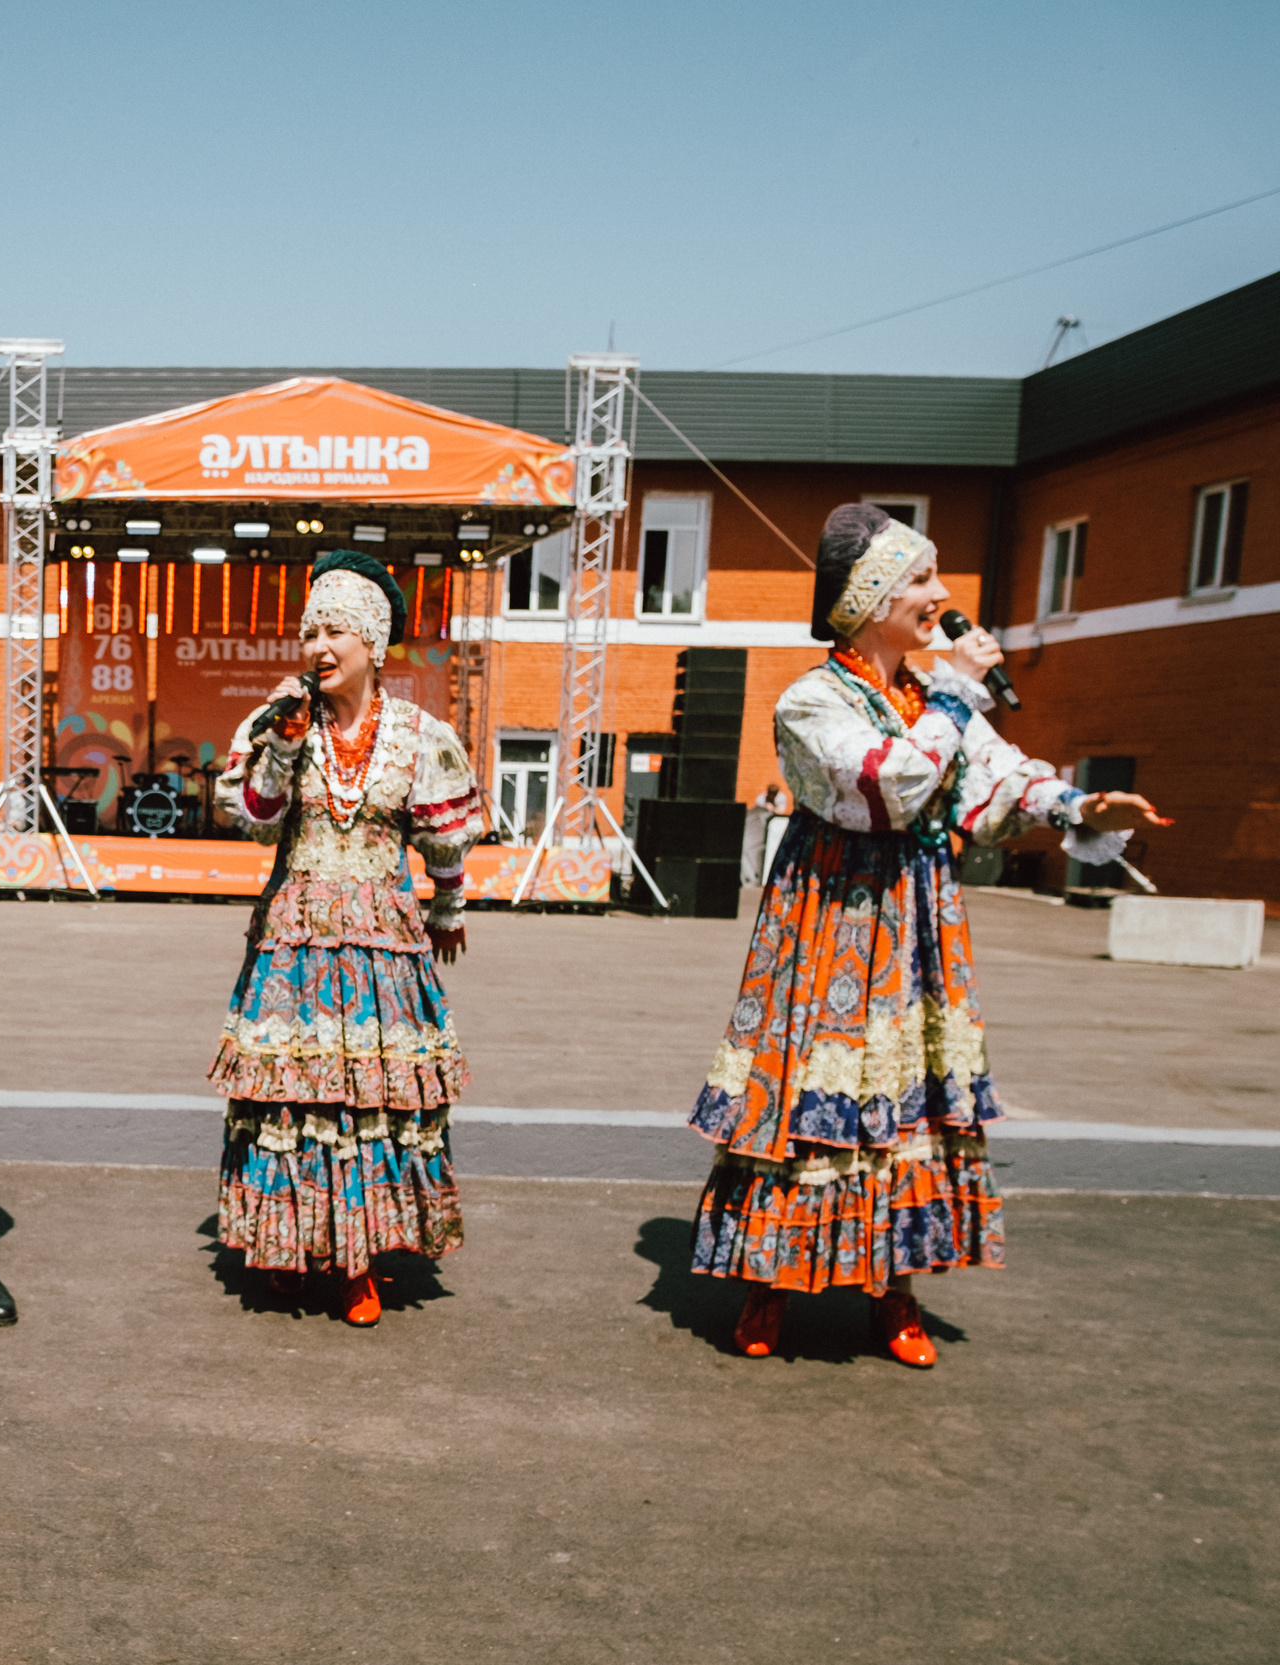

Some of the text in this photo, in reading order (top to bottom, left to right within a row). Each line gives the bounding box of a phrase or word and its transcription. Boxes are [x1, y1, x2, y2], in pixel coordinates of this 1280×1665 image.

[93, 603, 133, 630] 69
[92, 634, 132, 661] 76
[91, 664, 133, 691] 88
